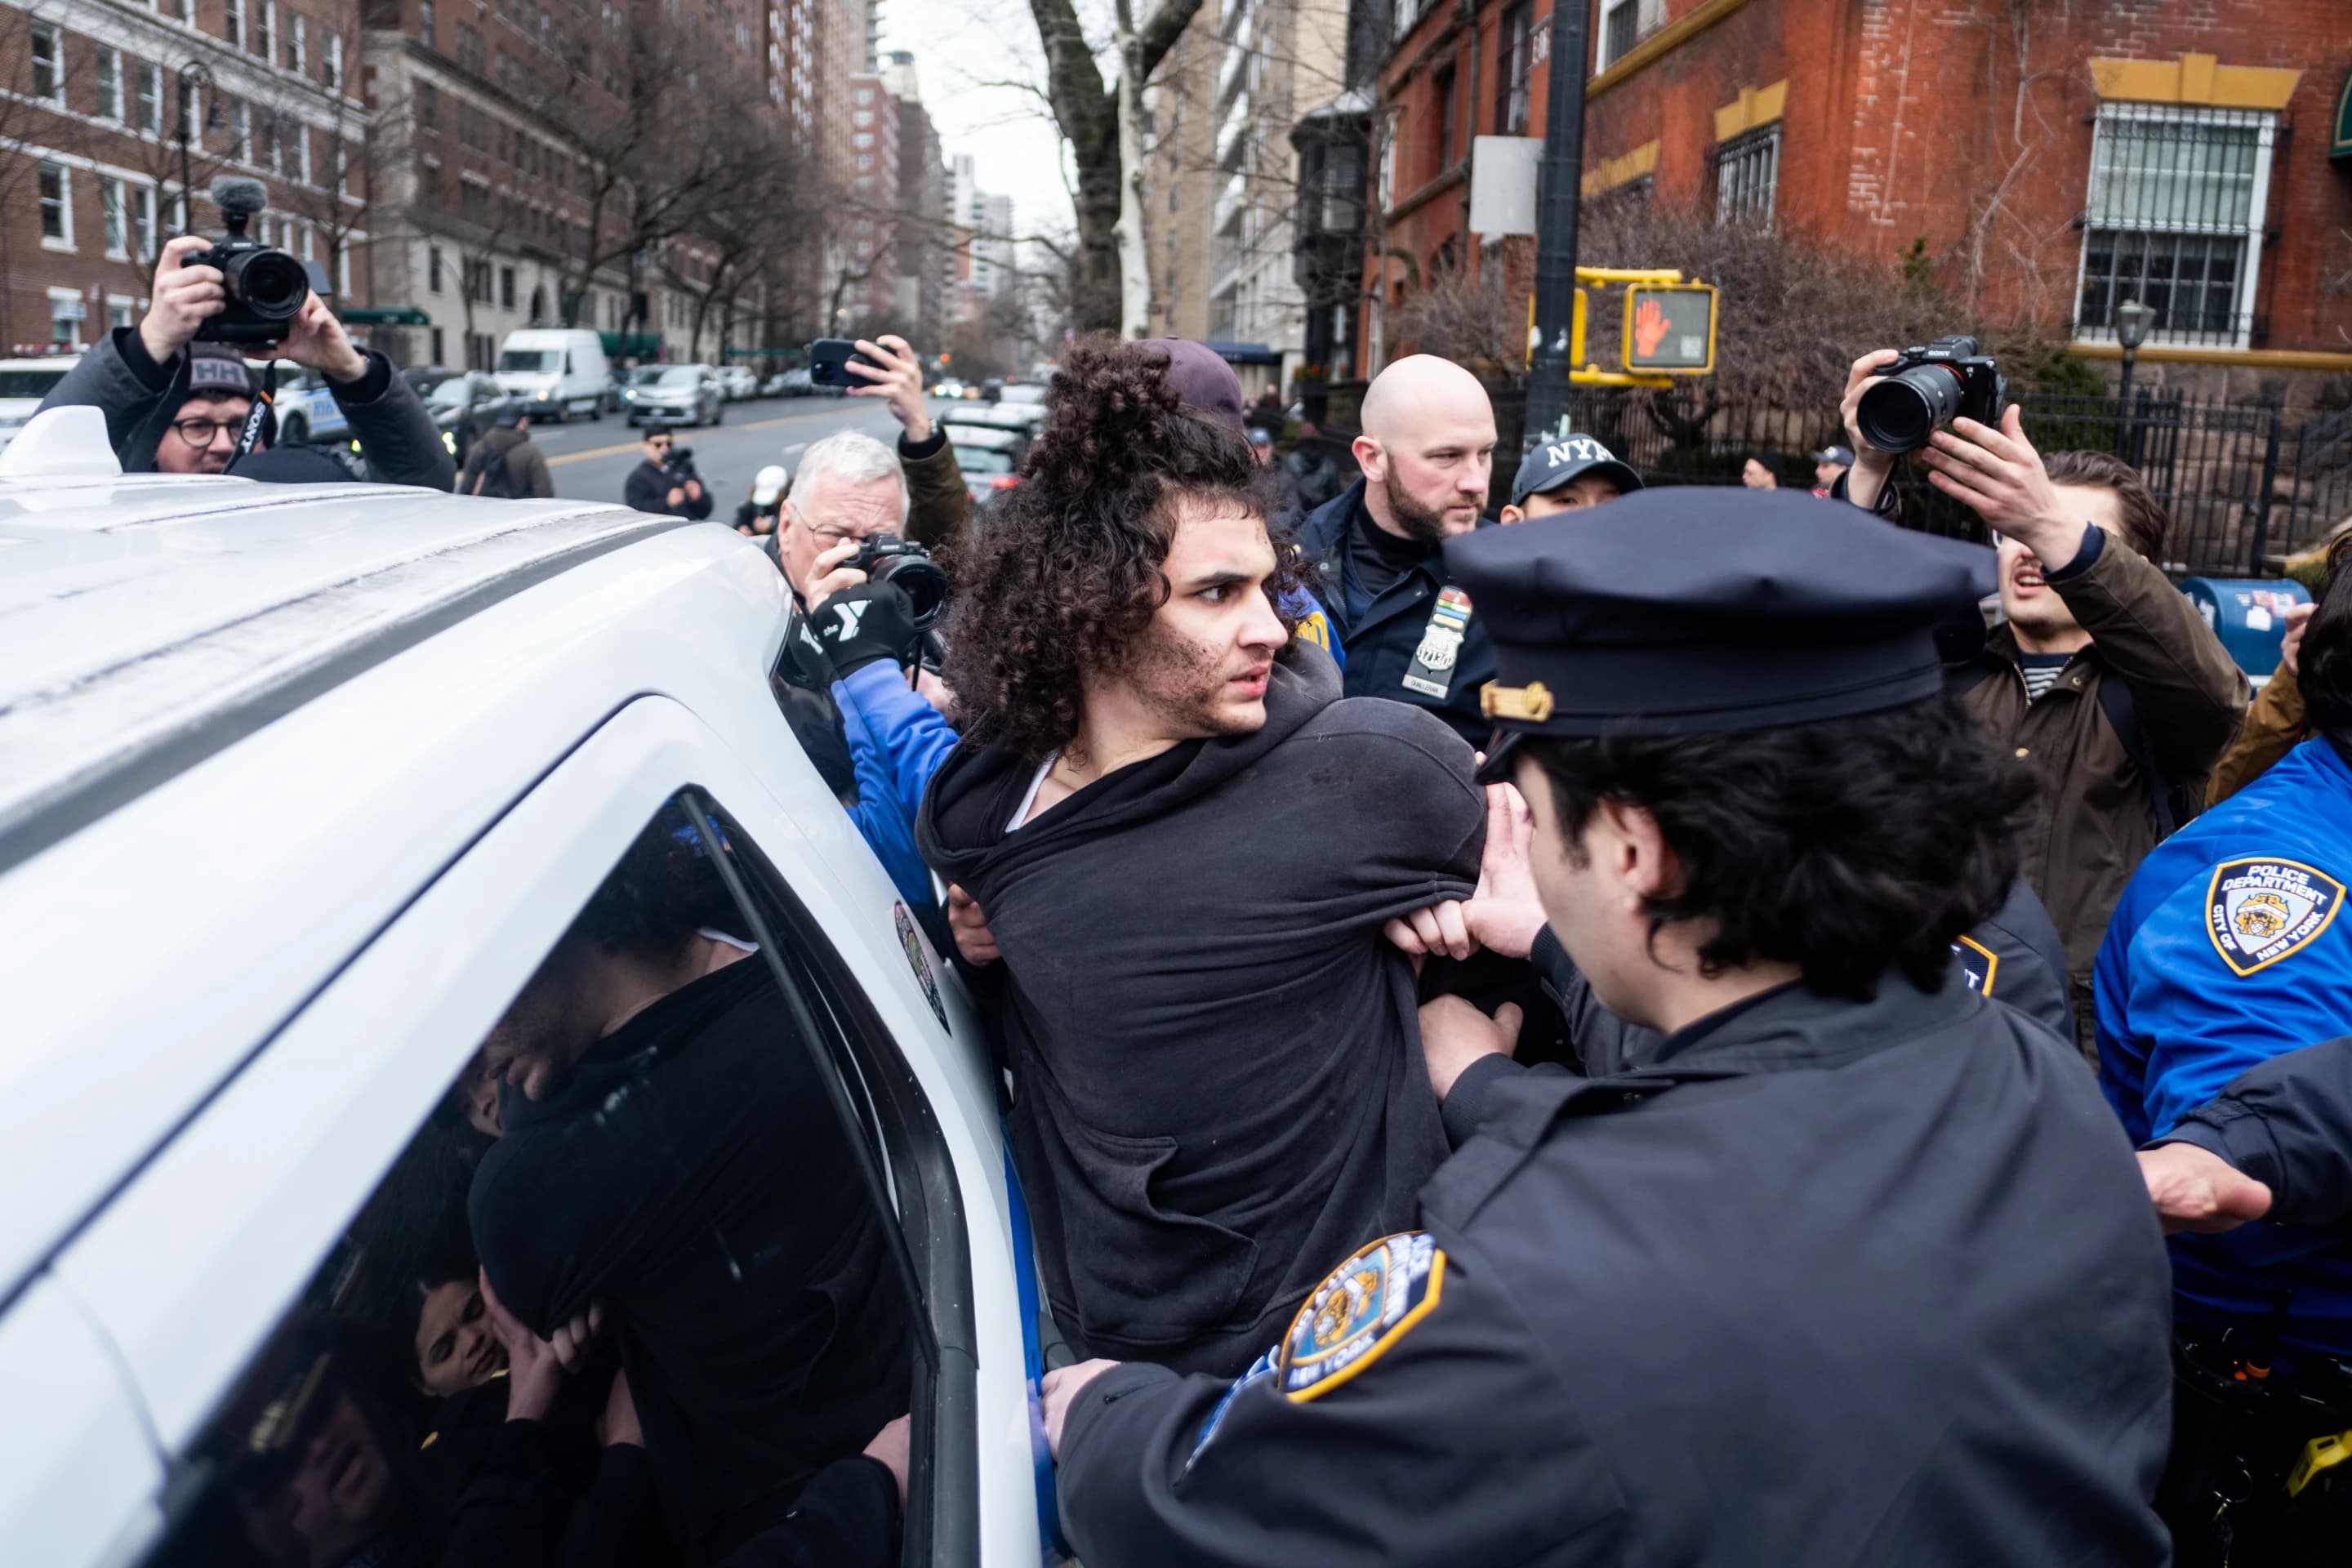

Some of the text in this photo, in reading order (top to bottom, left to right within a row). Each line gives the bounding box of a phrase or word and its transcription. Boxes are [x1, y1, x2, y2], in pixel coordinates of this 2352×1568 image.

[196, 363, 242, 381] HH
[242, 401, 266, 453] SONY
[823, 624, 839, 636] the
[2247, 865, 2311, 885] POLICE
[2221, 876, 2328, 906] DEPARTMENT
[2213, 904, 2238, 951] CITY OF
[2256, 911, 2325, 961] NEW YORK
